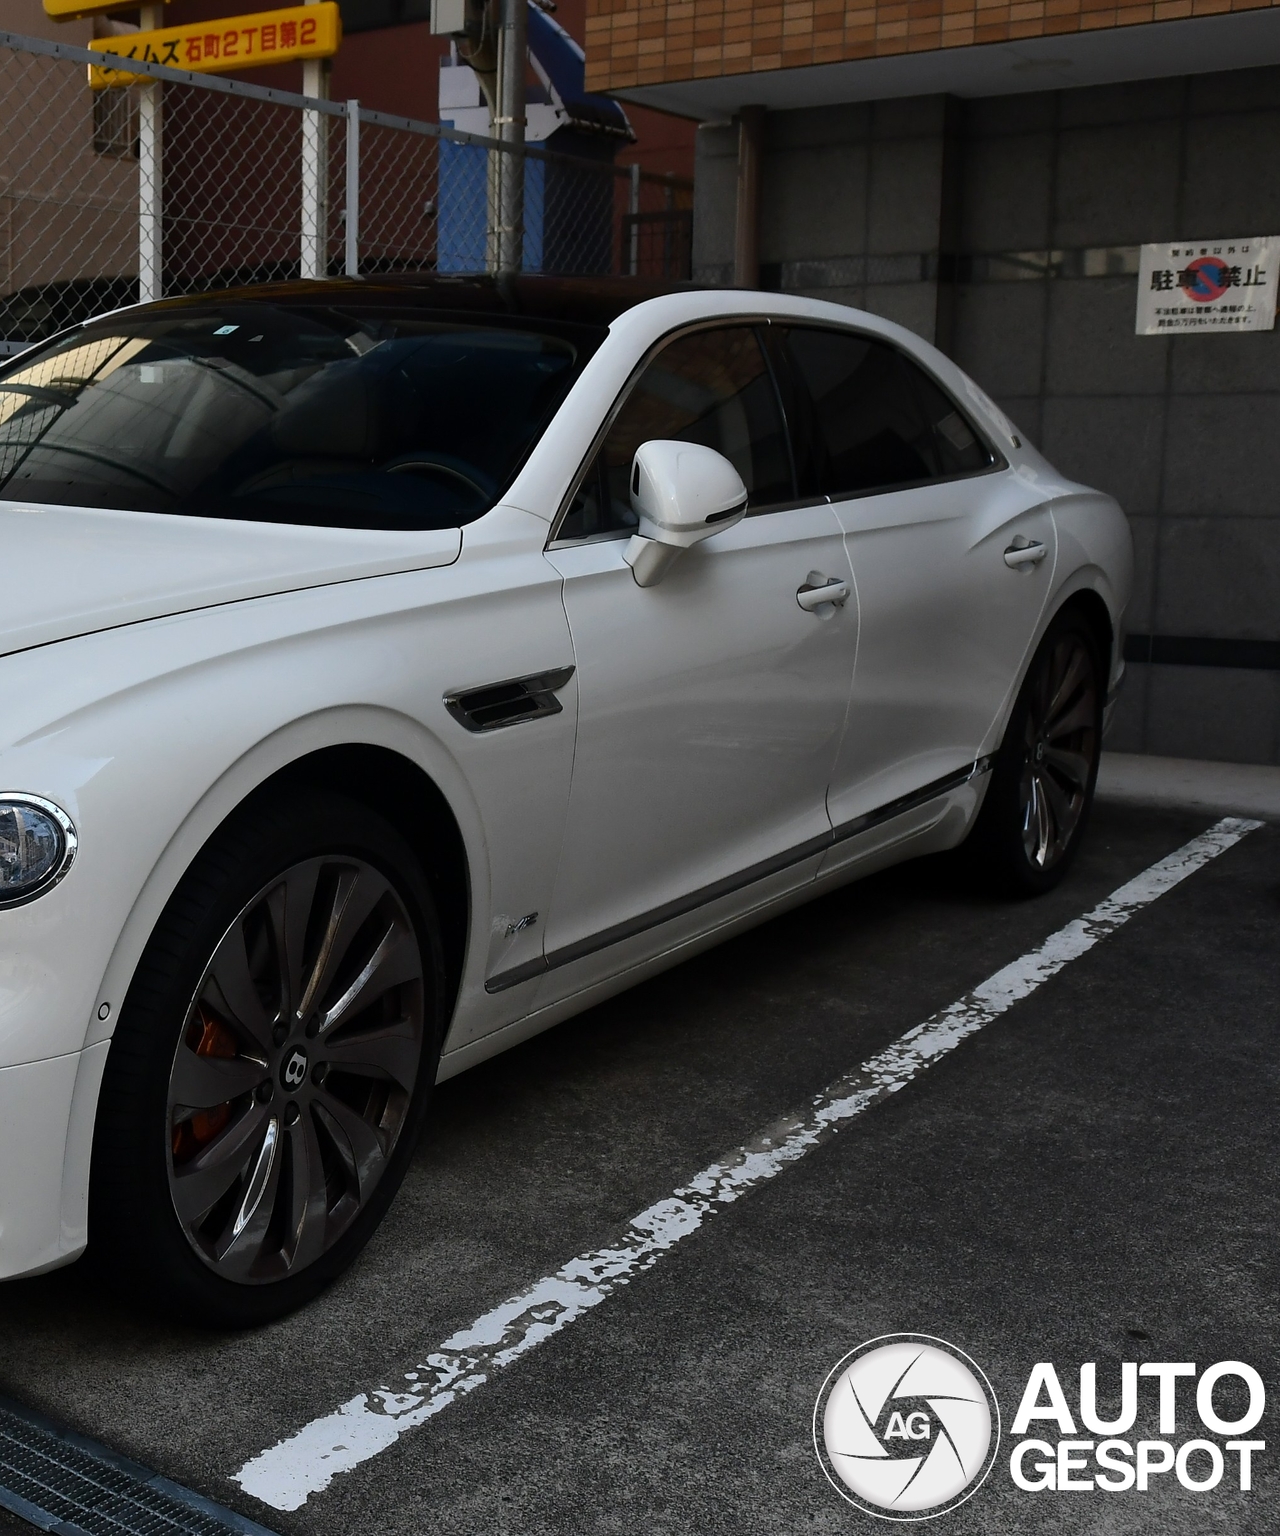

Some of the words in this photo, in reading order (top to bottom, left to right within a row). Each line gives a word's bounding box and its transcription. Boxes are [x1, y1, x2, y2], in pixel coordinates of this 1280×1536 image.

[185, 18, 317, 64] 石町2丁目第2
